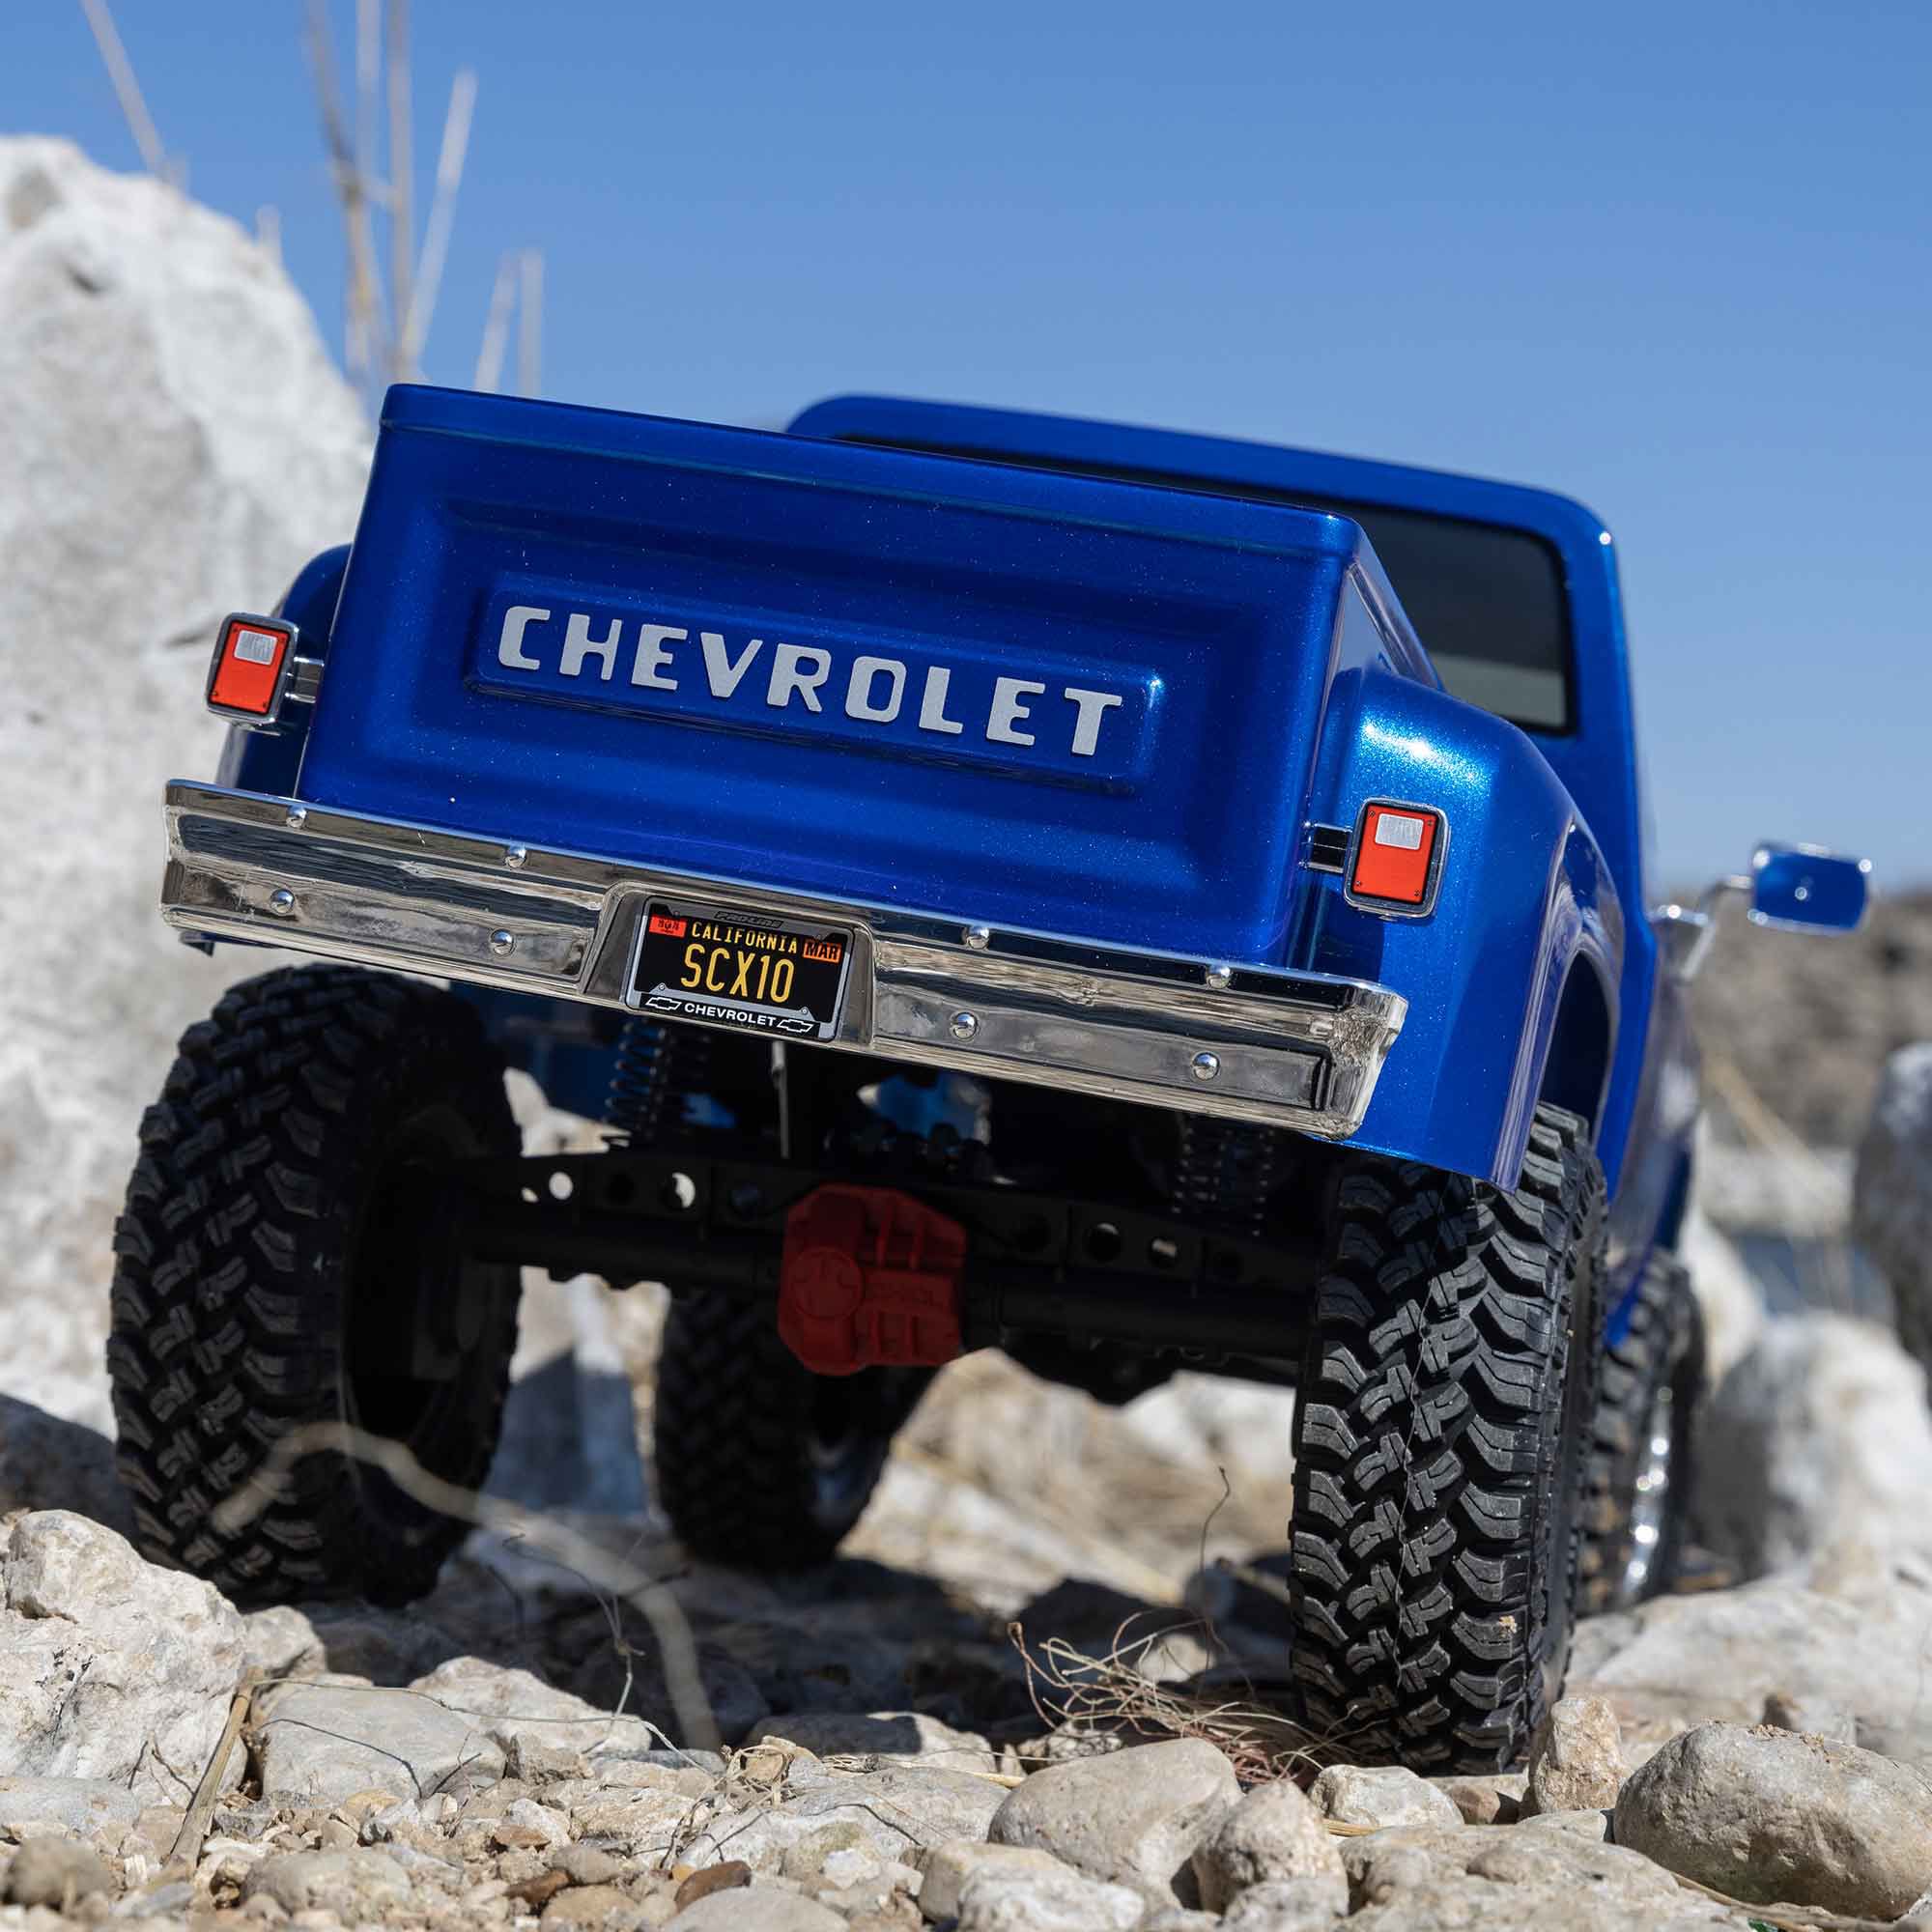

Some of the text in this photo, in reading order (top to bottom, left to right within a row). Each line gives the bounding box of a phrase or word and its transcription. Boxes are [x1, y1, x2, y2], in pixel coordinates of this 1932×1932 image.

[497, 605, 1122, 756] CHEVROLET
[691, 922, 798, 954] CALIFORNIA
[806, 942, 838, 960] MAR
[680, 943, 795, 1004] SCX10
[684, 1003, 777, 1027] CHEVROLET
